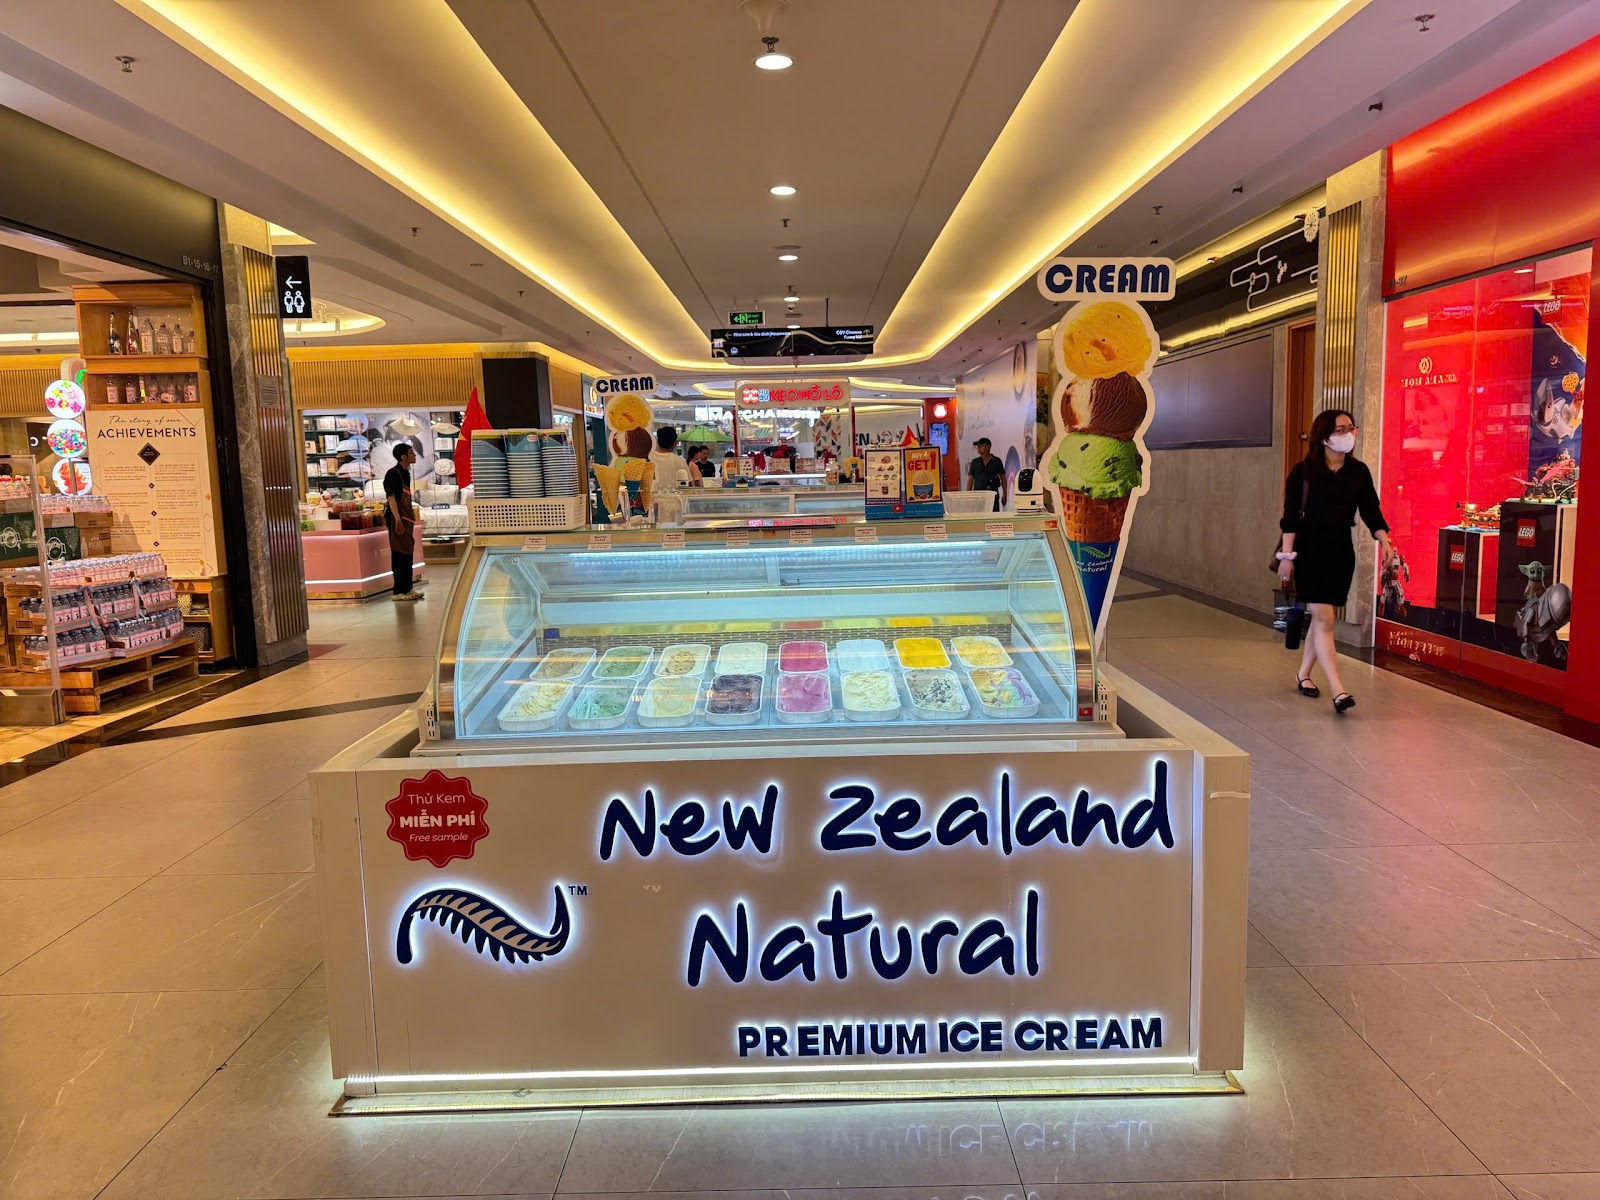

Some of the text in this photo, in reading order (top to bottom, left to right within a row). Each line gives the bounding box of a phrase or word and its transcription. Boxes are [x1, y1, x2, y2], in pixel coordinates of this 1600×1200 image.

[1045, 264, 1171, 294] CREAM
[1543, 301, 1560, 313] LEGO
[596, 376, 653, 393] CREAM
[770, 384, 843, 405] KẸO HỒ LÔ
[709, 408, 775, 420] MACHA
[97, 427, 196, 438] ACHIEVEMENTS
[908, 451, 937, 471] GET 1
[1518, 527, 1536, 539] LEGO
[1451, 552, 1464, 563] LEGO
[407, 792, 466, 805] Thử Kem
[400, 809, 476, 829] MIỄN PHÍ
[600, 760, 1175, 861] New Zealand
[409, 832, 468, 843] Free sample
[687, 888, 1040, 987] Natural
[738, 1017, 1163, 1057] PREMIUM ICE CREAM
